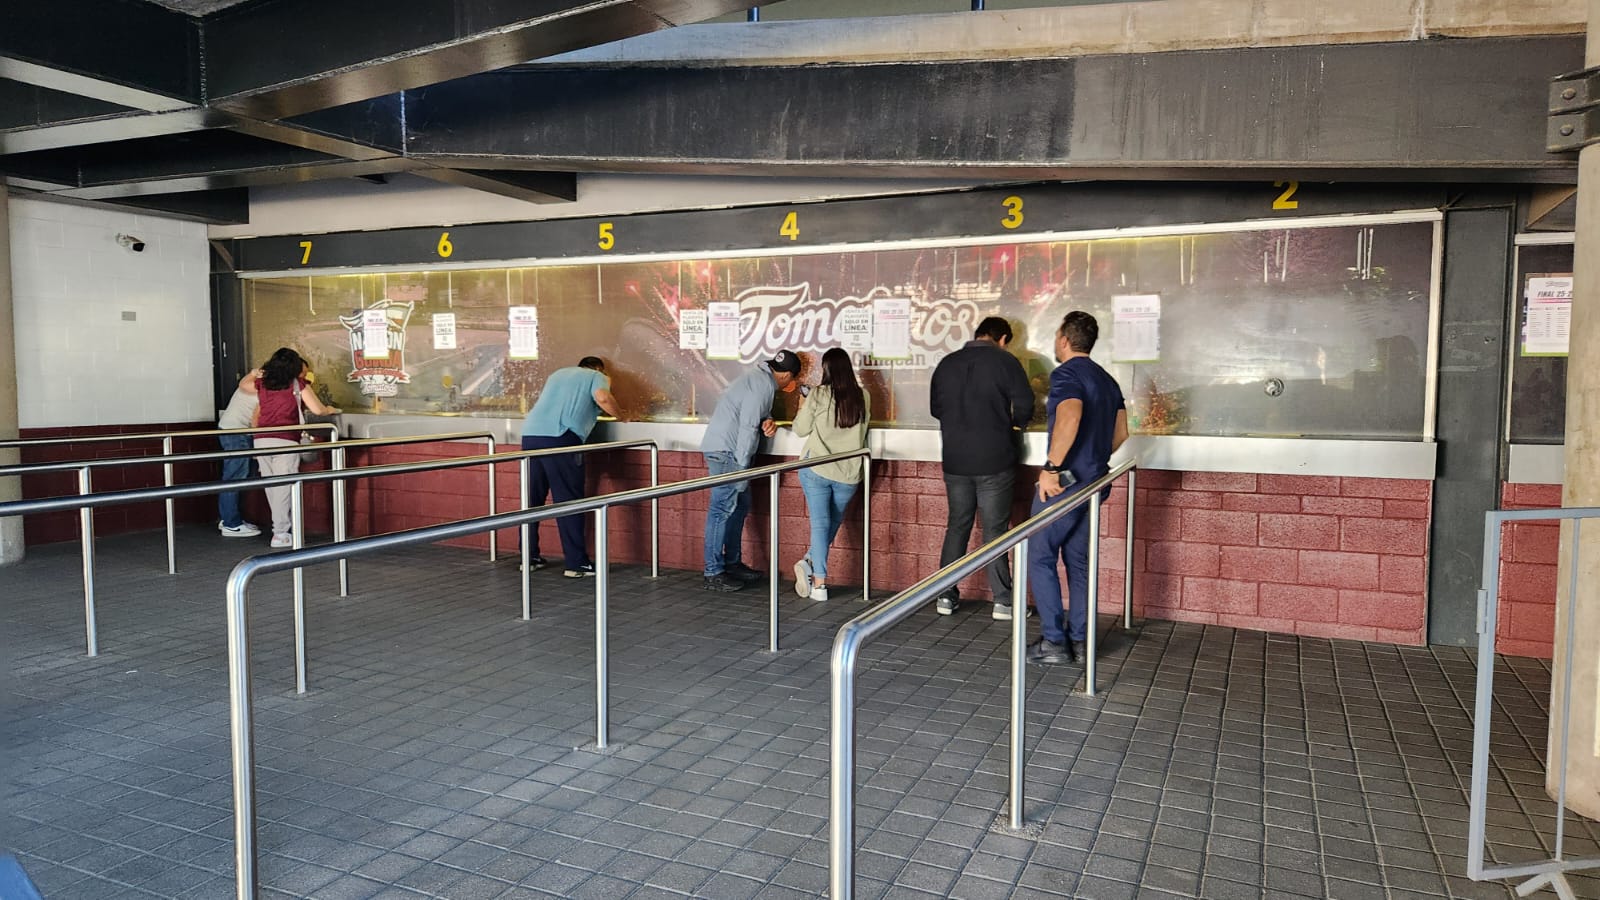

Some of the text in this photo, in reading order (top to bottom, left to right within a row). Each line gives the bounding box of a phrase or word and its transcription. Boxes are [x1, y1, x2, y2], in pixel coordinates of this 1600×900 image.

[1273, 182, 1299, 210] 2
[780, 212, 801, 241] 4
[1001, 196, 1024, 229] 3
[437, 232, 453, 258] 6
[598, 223, 615, 250] 5
[300, 242, 313, 265] 7
[739, 289, 973, 357] Tomros
